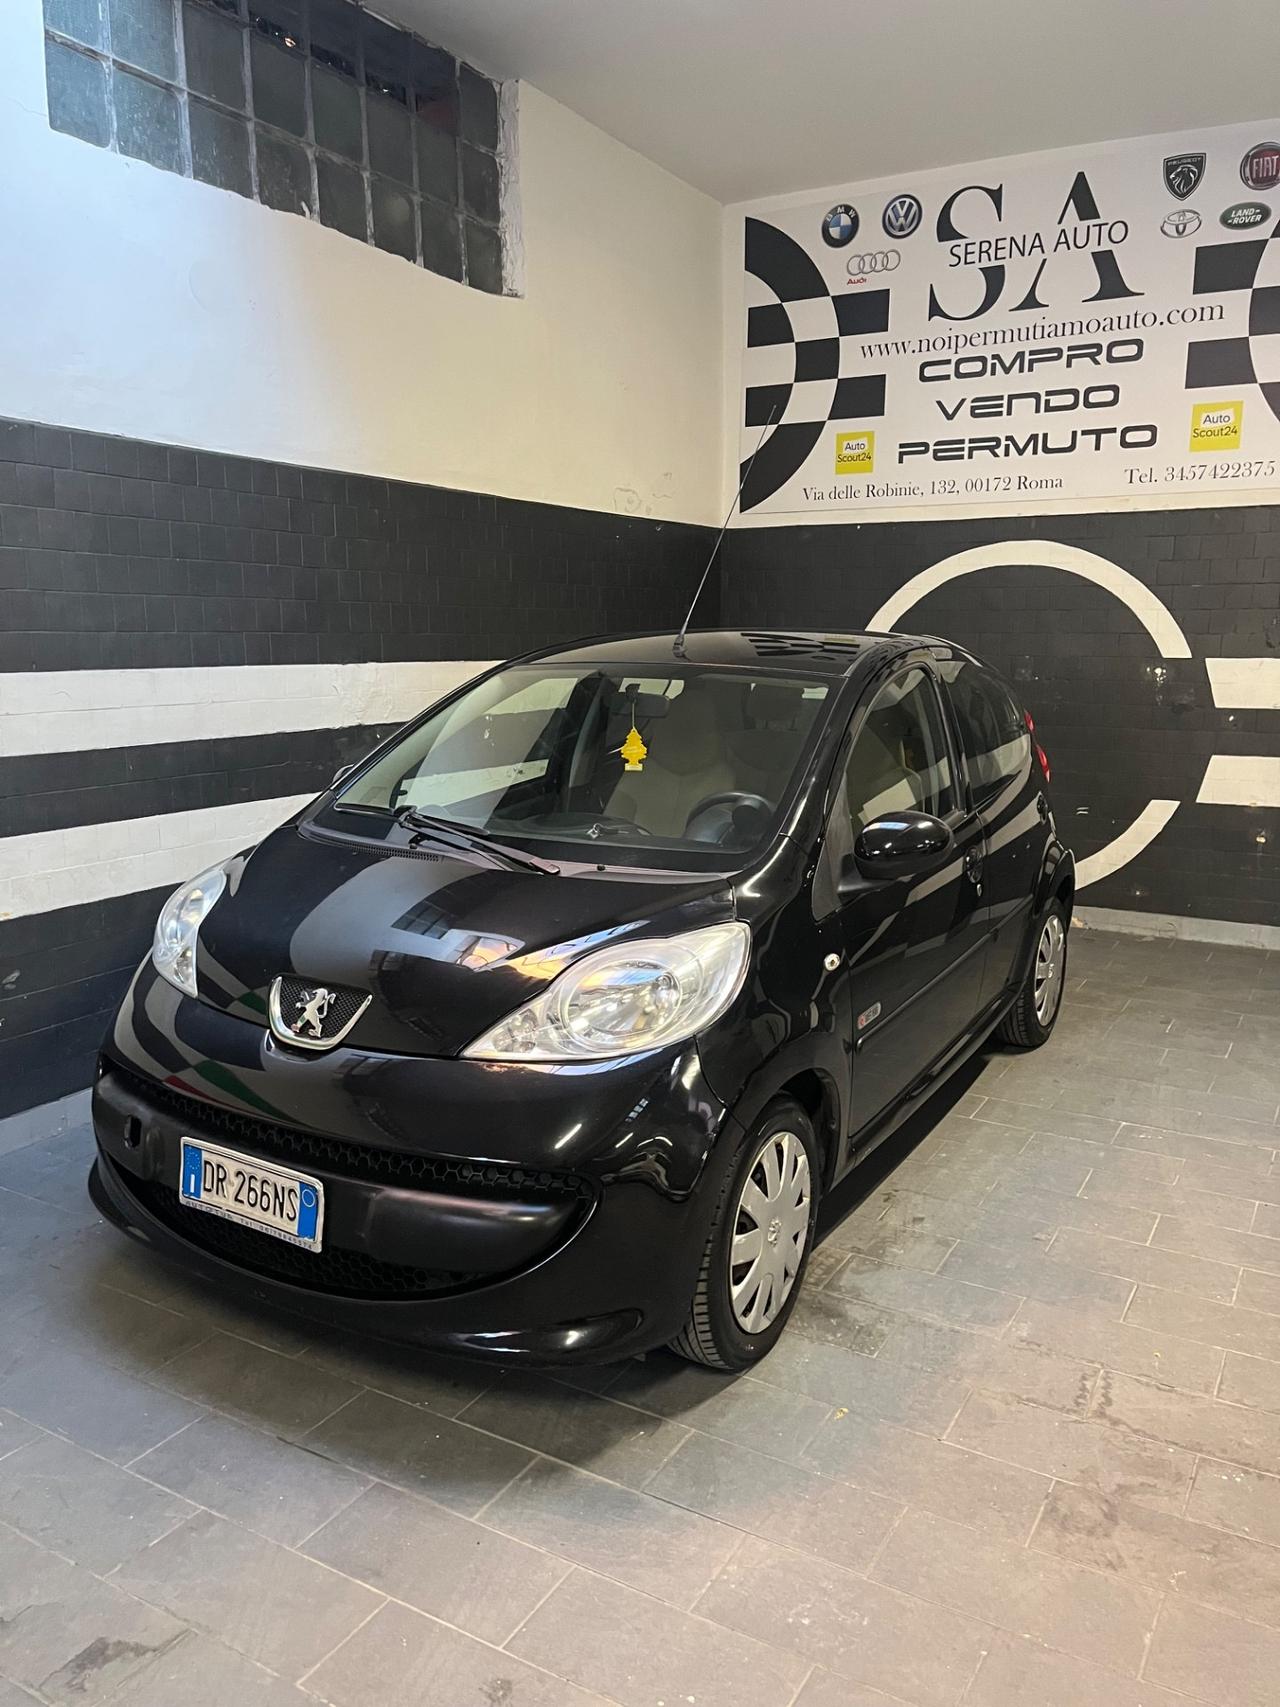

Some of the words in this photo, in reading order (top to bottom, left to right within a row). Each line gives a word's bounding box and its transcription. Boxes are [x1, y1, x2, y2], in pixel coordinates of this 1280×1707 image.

[1252, 156, 1279, 178] FIAT
[949, 232, 1045, 268] SERENA
[1053, 220, 1129, 253] AUTO
[860, 303, 1225, 360] www.noipermutiamoauto.com
[918, 337, 1145, 383] COMPRO
[1192, 425, 1238, 439] Scout24
[1202, 414, 1231, 425] Auto
[844, 441, 866, 451] Auto
[897, 423, 1159, 465] PERMUTO
[837, 452, 872, 463] Scout24
[1124, 467, 1158, 484] Tel.
[1164, 459, 1276, 482] 3457422375
[802, 486, 825, 501] Via
[828, 484, 861, 500] delle
[866, 480, 924, 499] Robinie,
[930, 479, 960, 496] 132,
[965, 475, 1012, 493] 00172
[1017, 473, 1064, 491] Roma
[203, 1160, 227, 1198] DR
[234, 1171, 299, 1222] 266NS
